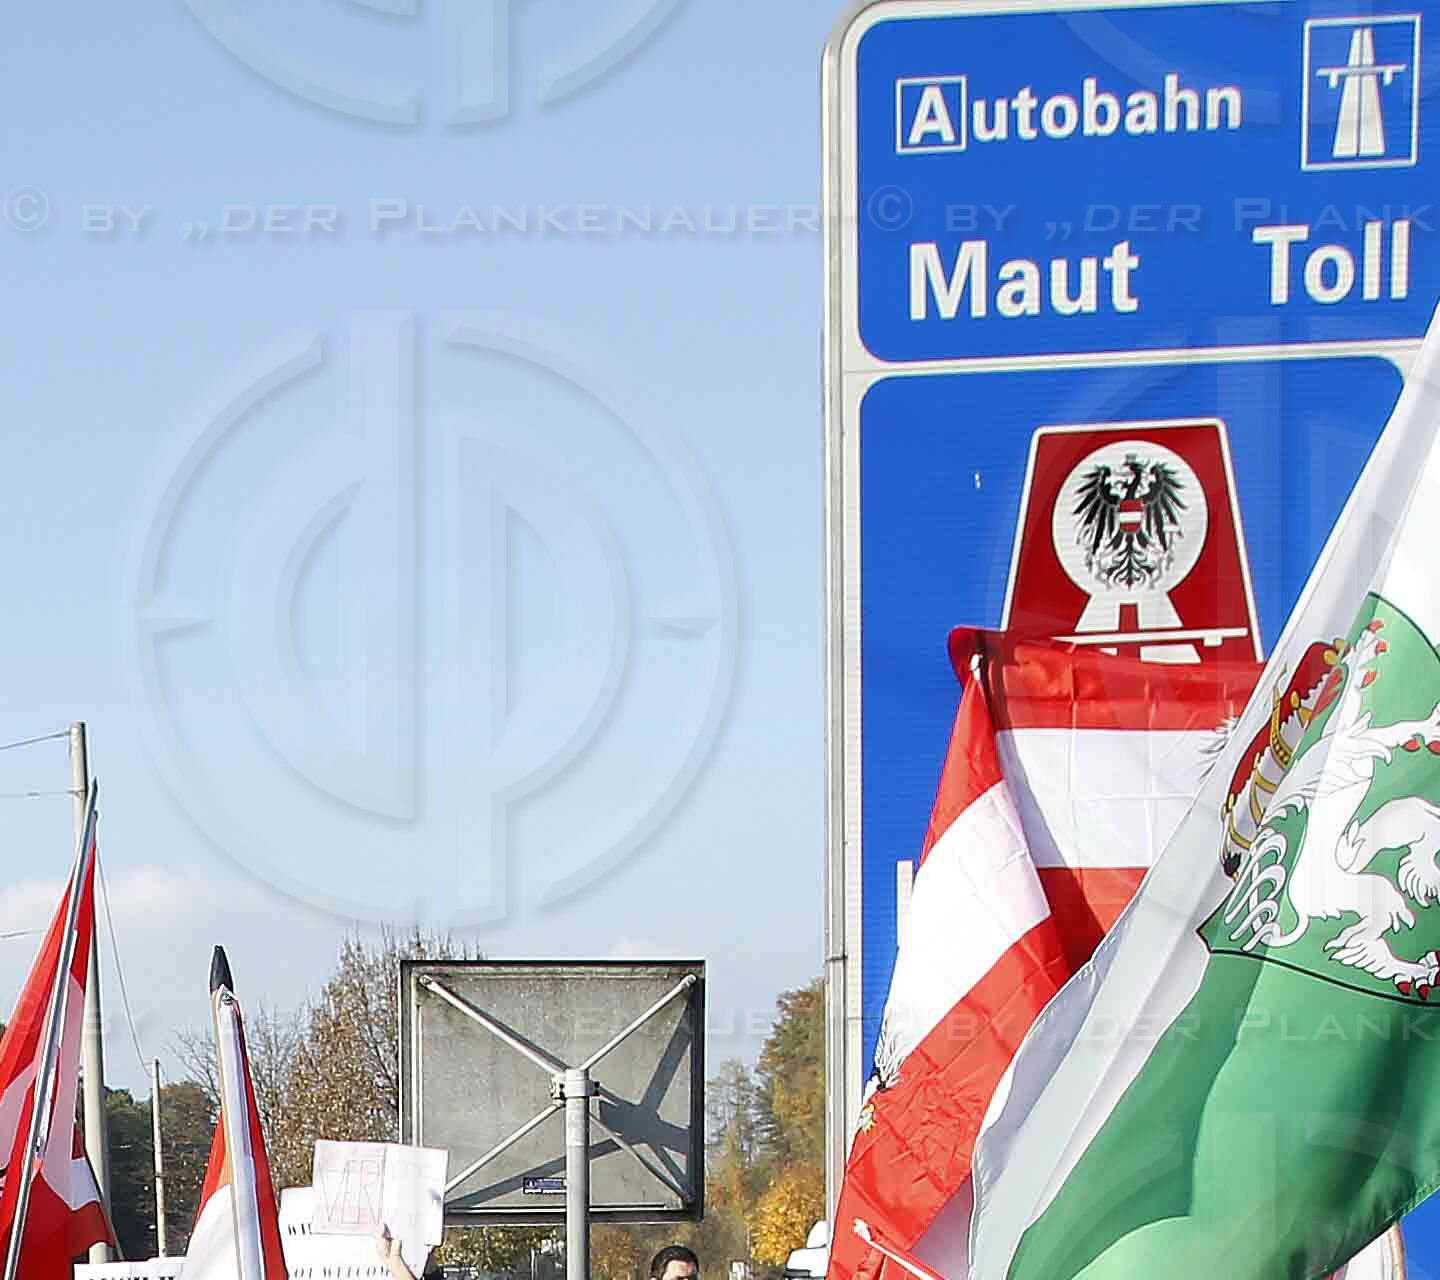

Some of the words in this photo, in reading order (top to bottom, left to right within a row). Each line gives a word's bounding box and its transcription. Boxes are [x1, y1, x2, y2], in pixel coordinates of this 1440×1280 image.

[907, 73, 1244, 147] Autobahn
[908, 240, 1140, 321] Maut
[1251, 220, 1411, 305] Toll
